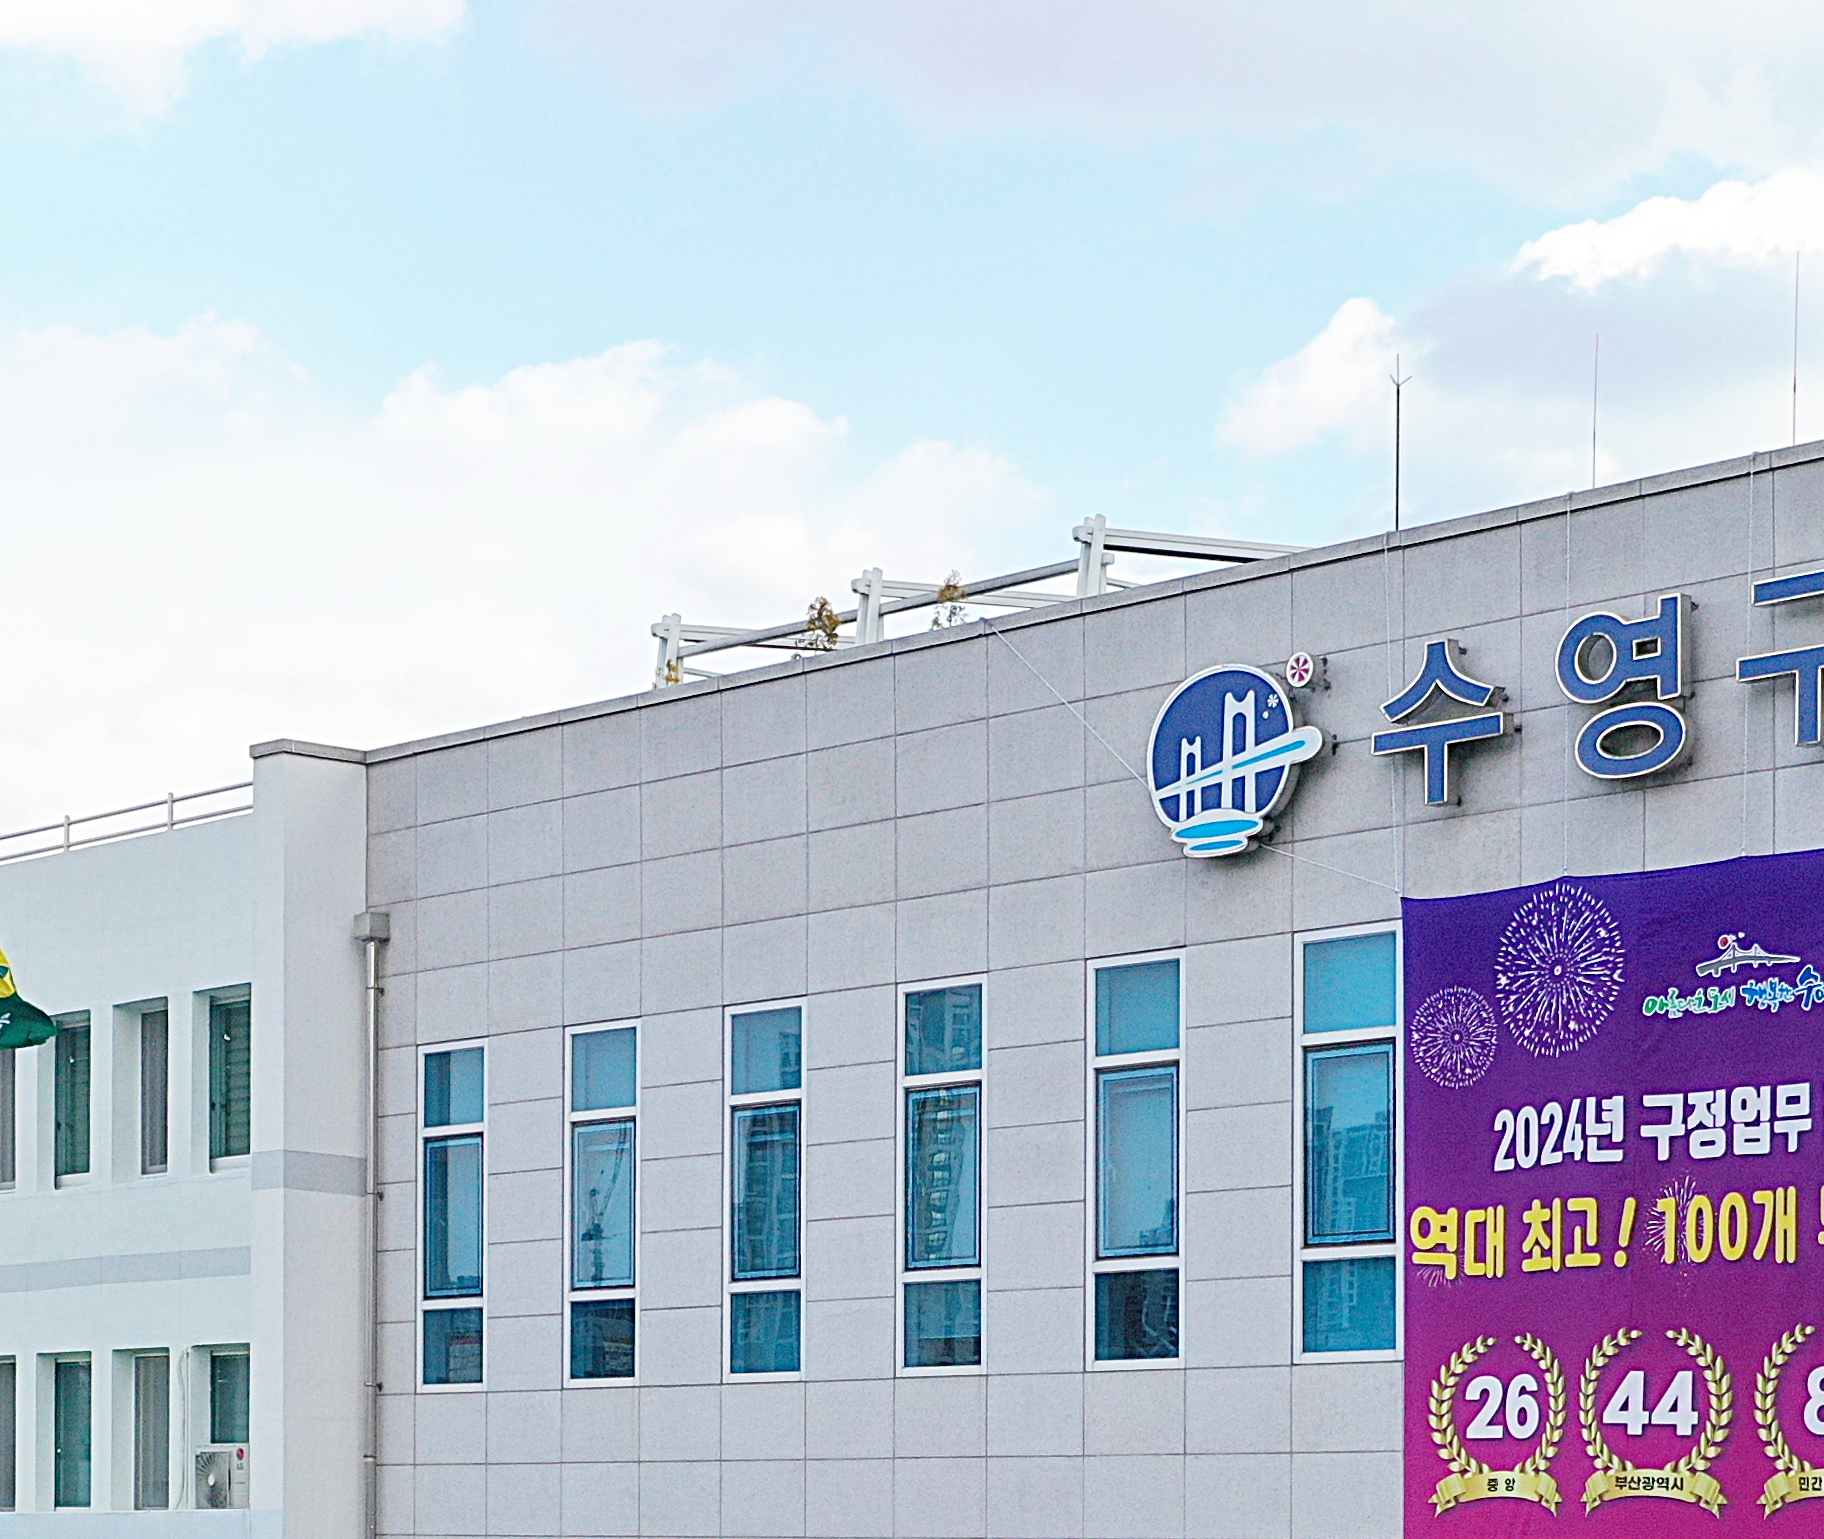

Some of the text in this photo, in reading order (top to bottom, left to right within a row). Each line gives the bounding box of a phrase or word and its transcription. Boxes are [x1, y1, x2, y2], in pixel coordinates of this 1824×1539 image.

[1492, 1092, 1624, 1174] 2024년
[1639, 1088, 1815, 1161] 구정업무
[1408, 1203, 1505, 1281] 역대
[1655, 1188, 1796, 1265] 100개
[1464, 1375, 1540, 1439] 26
[1602, 1369, 1699, 1436] 44
[1614, 1474, 1685, 1493] 부산광역시
